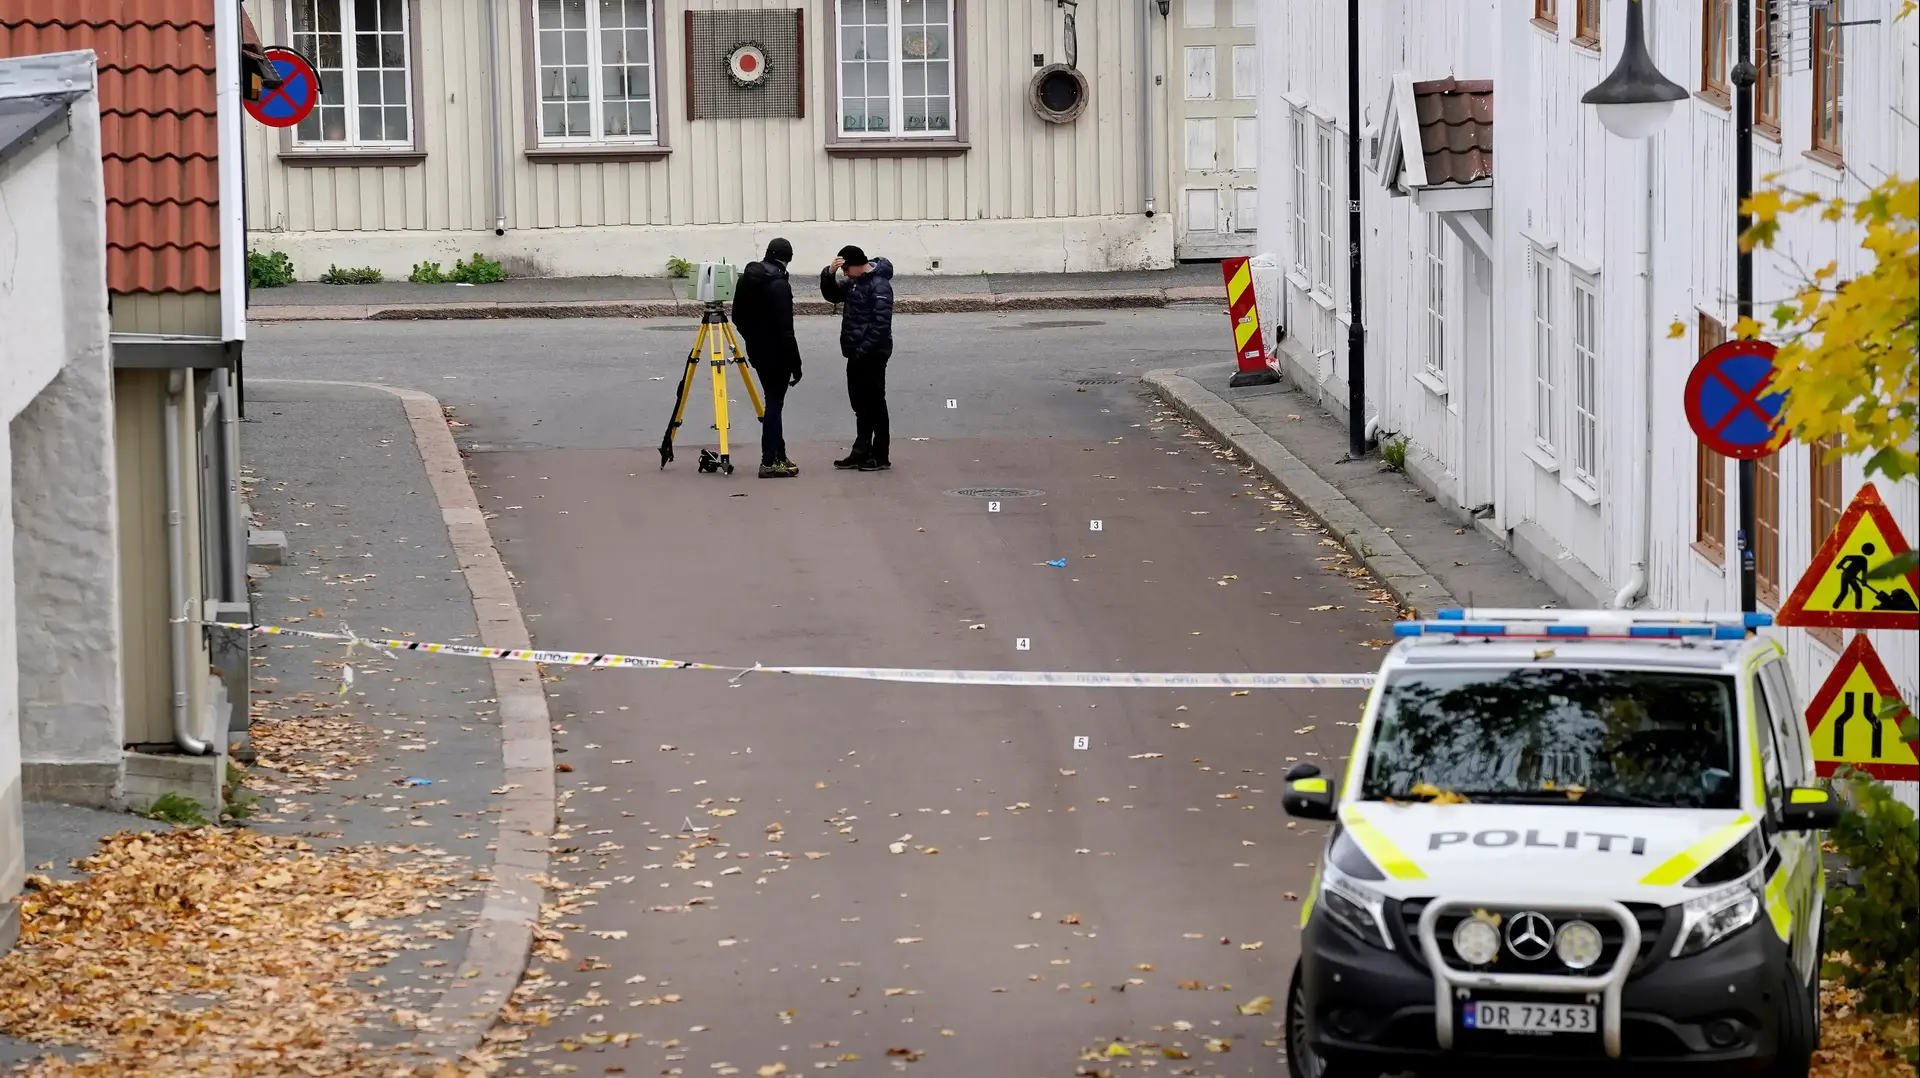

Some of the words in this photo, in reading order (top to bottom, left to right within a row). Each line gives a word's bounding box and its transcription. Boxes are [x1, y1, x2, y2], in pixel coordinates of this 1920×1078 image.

[1428, 829, 1647, 855] POLITI
[1481, 1006, 1510, 1025] DR
[1521, 1007, 1590, 1028] 72453
